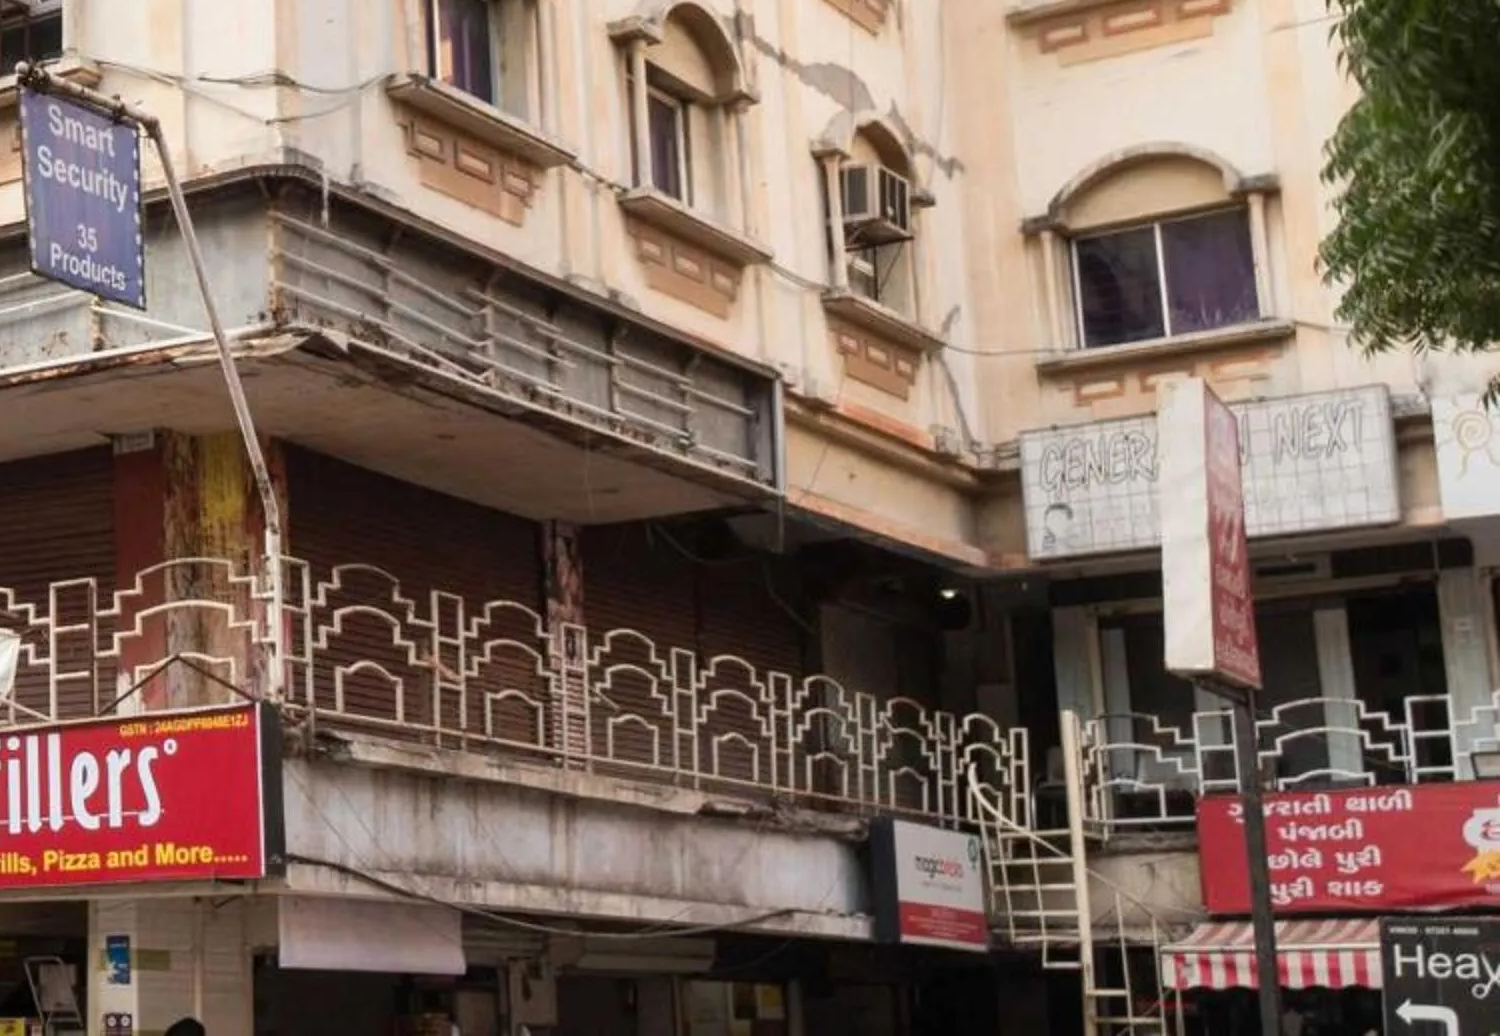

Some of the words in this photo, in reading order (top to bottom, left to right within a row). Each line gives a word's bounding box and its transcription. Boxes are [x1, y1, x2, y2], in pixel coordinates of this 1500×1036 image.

[47, 104, 117, 159] Smart
[36, 145, 129, 214] Security
[76, 223, 99, 254] 35
[51, 242, 127, 292] Products
[1274, 398, 1365, 467] NEXT
[43, 849, 101, 872] Pizza
[106, 845, 149, 868] and
